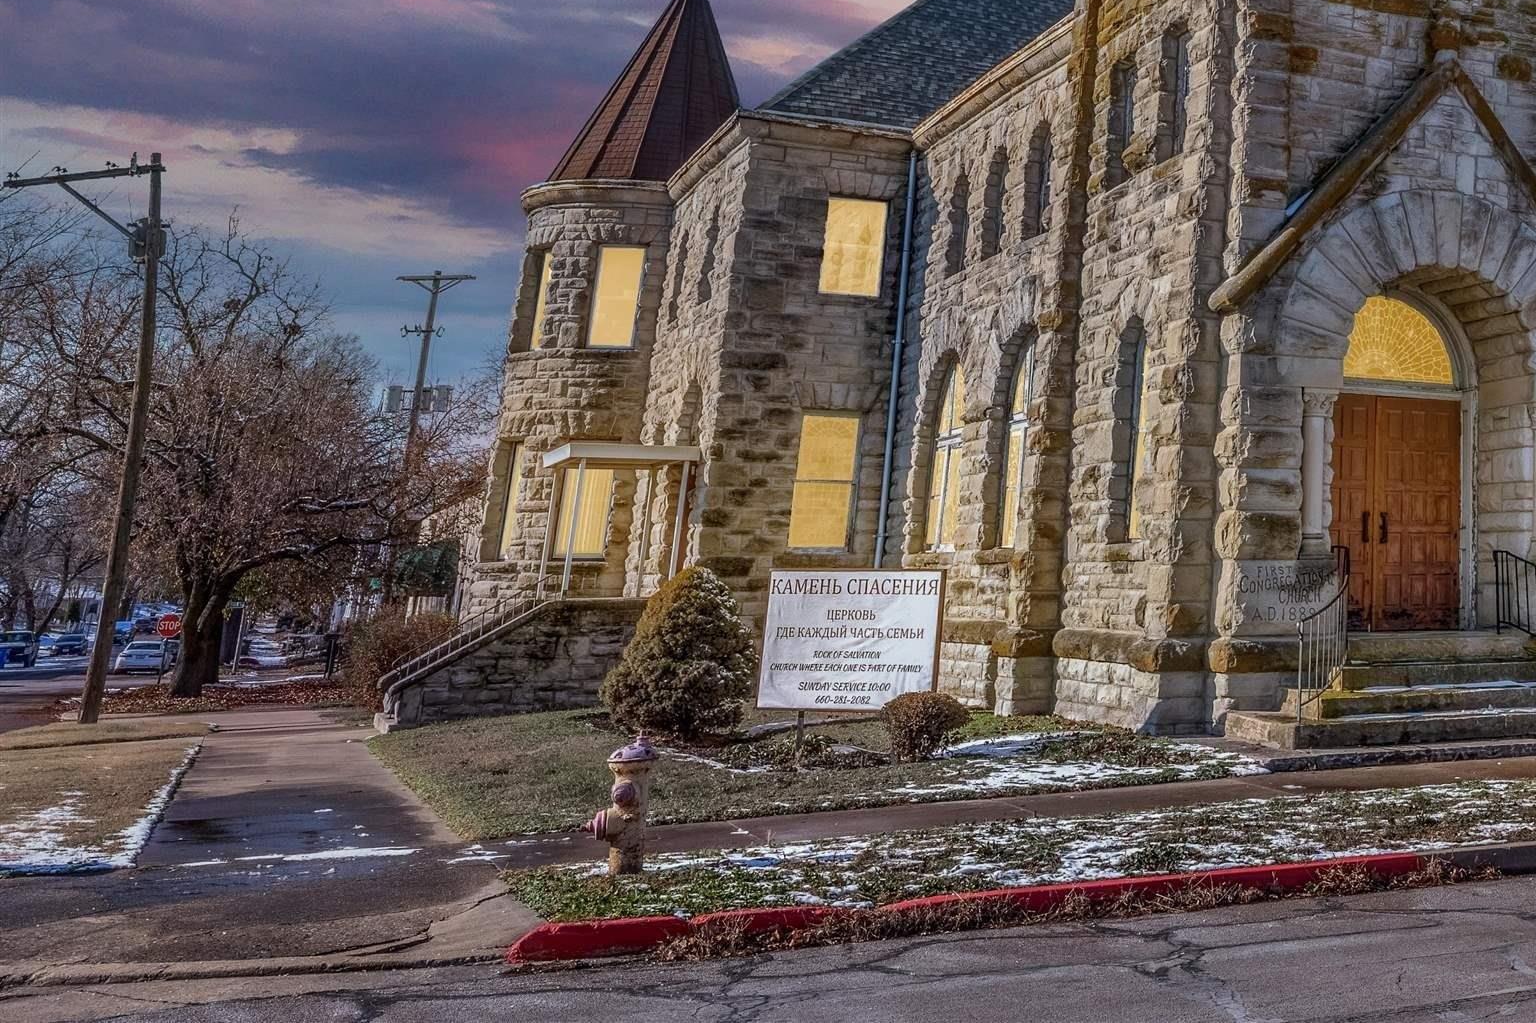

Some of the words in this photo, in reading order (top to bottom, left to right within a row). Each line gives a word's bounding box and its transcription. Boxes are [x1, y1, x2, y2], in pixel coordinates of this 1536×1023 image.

[1257, 566, 1292, 577] FIRST
[771, 578, 842, 595] КАМЕНЬ
[847, 578, 939, 596] СПАСЕНИЯ
[826, 609, 876, 621] ЦЕРКОВЬ
[159, 621, 181, 631] STOP
[775, 627, 795, 639] ГДЕ
[797, 625, 847, 640] КАЖДЫЙ
[850, 627, 884, 638] ЧАСТЬ
[886, 628, 925, 639] СЕМЬИ
[813, 650, 833, 659] ROCK
[833, 650, 842, 659] OF
[843, 650, 882, 659] SALVATION
[769, 663, 798, 671] CHURCH
[798, 663, 823, 671] WHERE
[823, 663, 841, 672] EACH
[842, 663, 859, 672] ONE
[859, 663, 867, 672] IS
[867, 663, 887, 673] PART
[886, 664, 897, 673] OF
[897, 664, 923, 673] FAMILY
[798, 681, 832, 691] SUNDAY
[832, 682, 866, 692] SERVICE
[867, 682, 891, 692] 10:00
[814, 695, 872, 705] 660-281-2082
